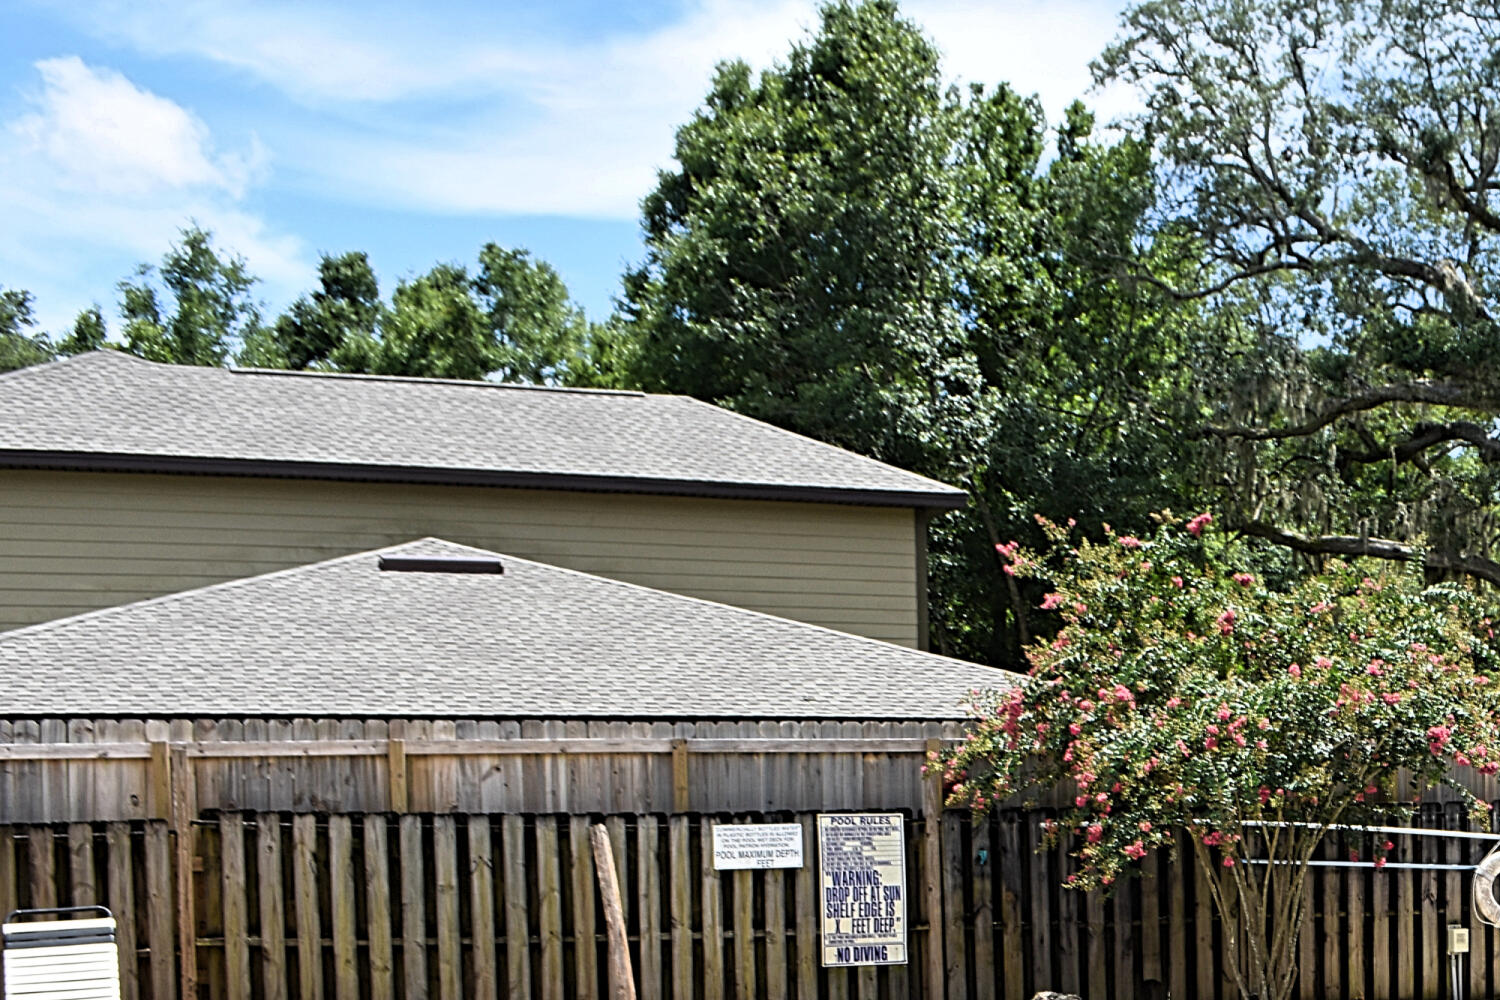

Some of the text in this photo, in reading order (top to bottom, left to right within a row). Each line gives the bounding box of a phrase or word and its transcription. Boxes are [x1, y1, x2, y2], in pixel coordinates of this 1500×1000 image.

[831, 816, 891, 825] POOL RULES
[716, 848, 800, 859] POOL MAXIMUM DEPTH
[757, 859, 774, 868] FEET
[826, 885, 901, 902] DROP OFF AT SUN
[826, 901, 895, 918] SHELF EDGE IS
[851, 918, 870, 934] FEET
[837, 946, 888, 962] NO DIVING
